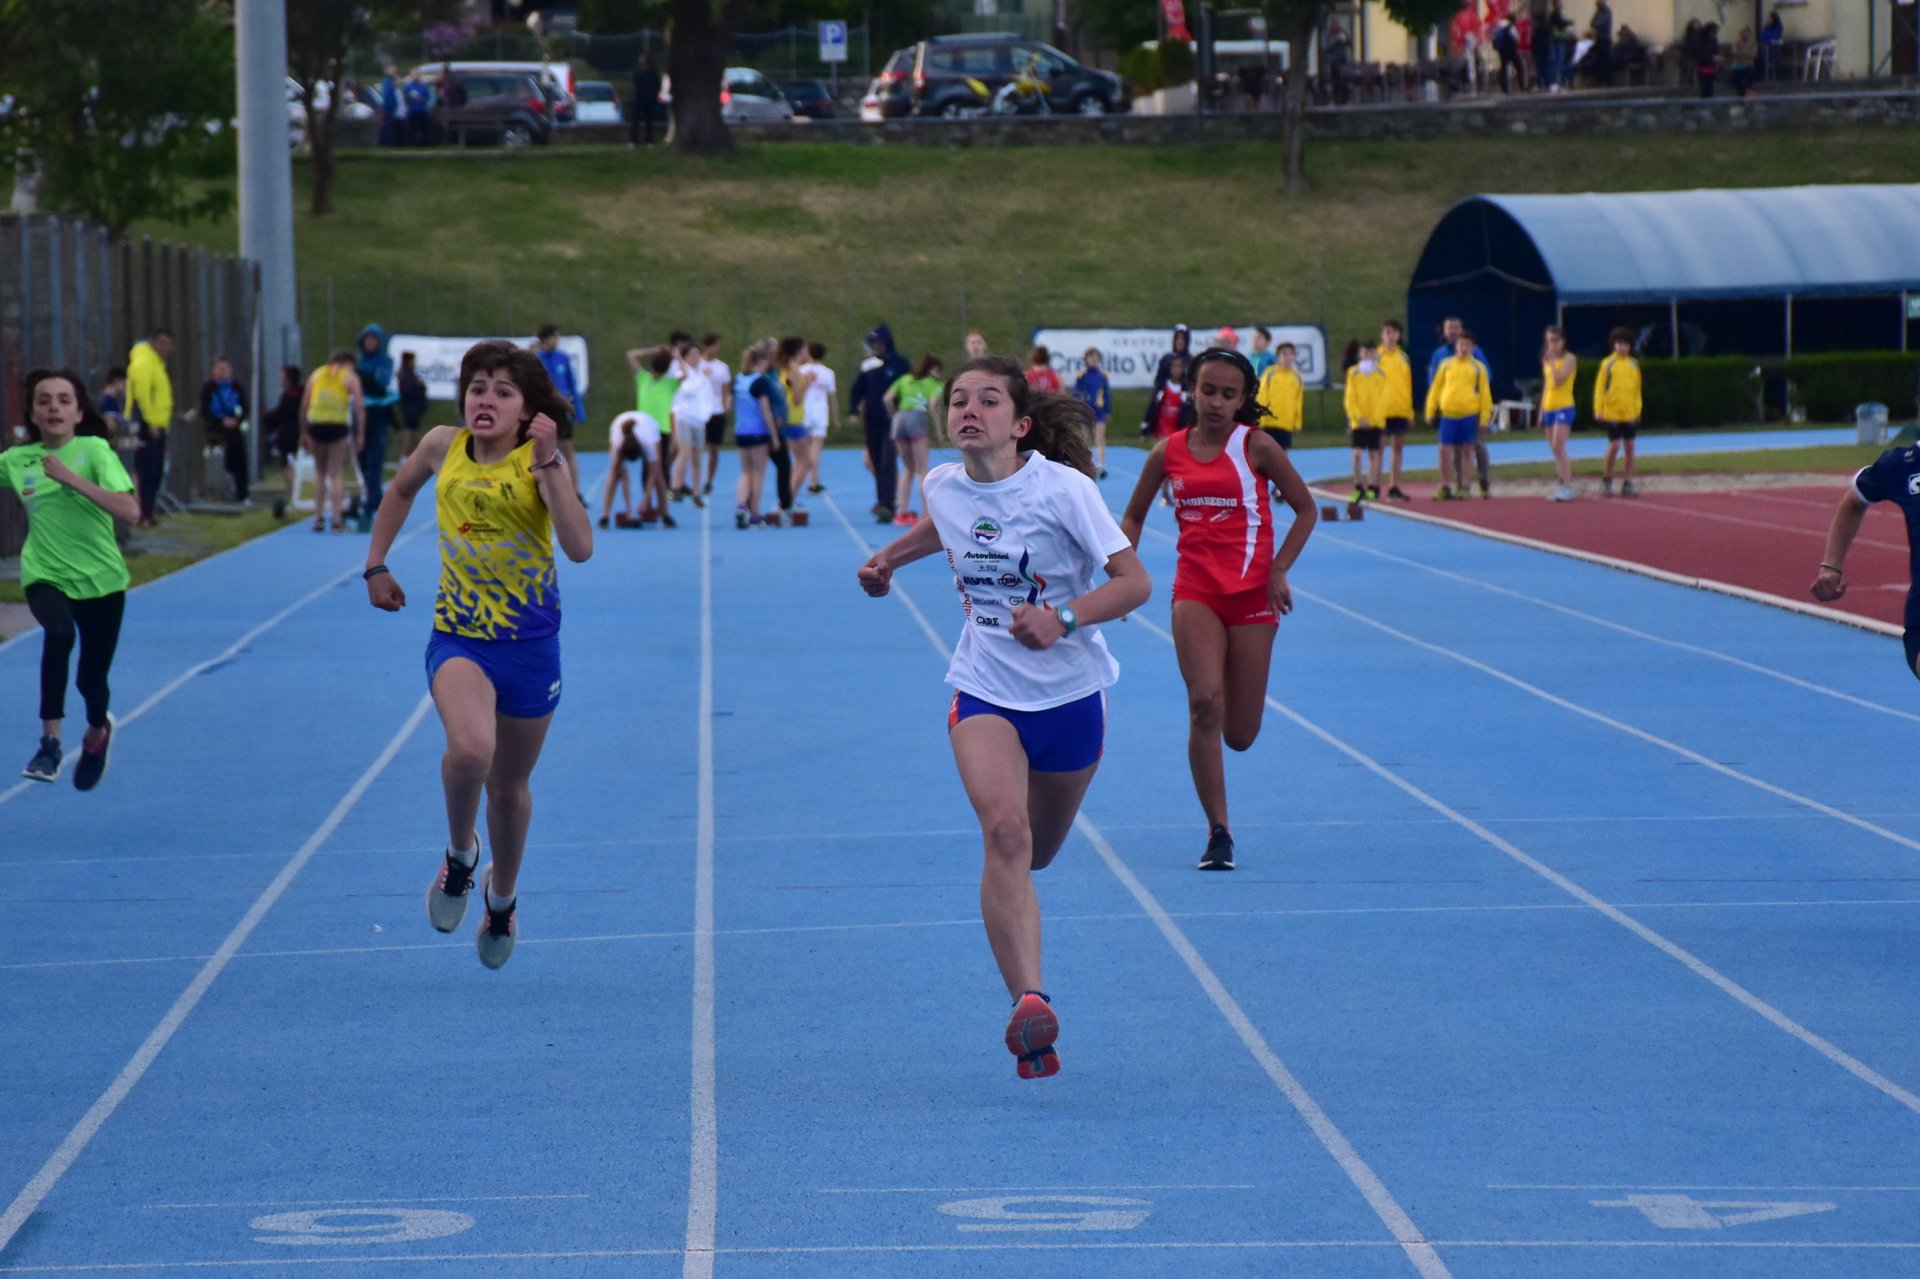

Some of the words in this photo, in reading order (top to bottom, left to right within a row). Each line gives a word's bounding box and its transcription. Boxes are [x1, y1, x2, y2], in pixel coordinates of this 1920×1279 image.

[826, 23, 841, 41] P
[934, 1195, 1154, 1232] 5
[1590, 1194, 1837, 1230] 4
